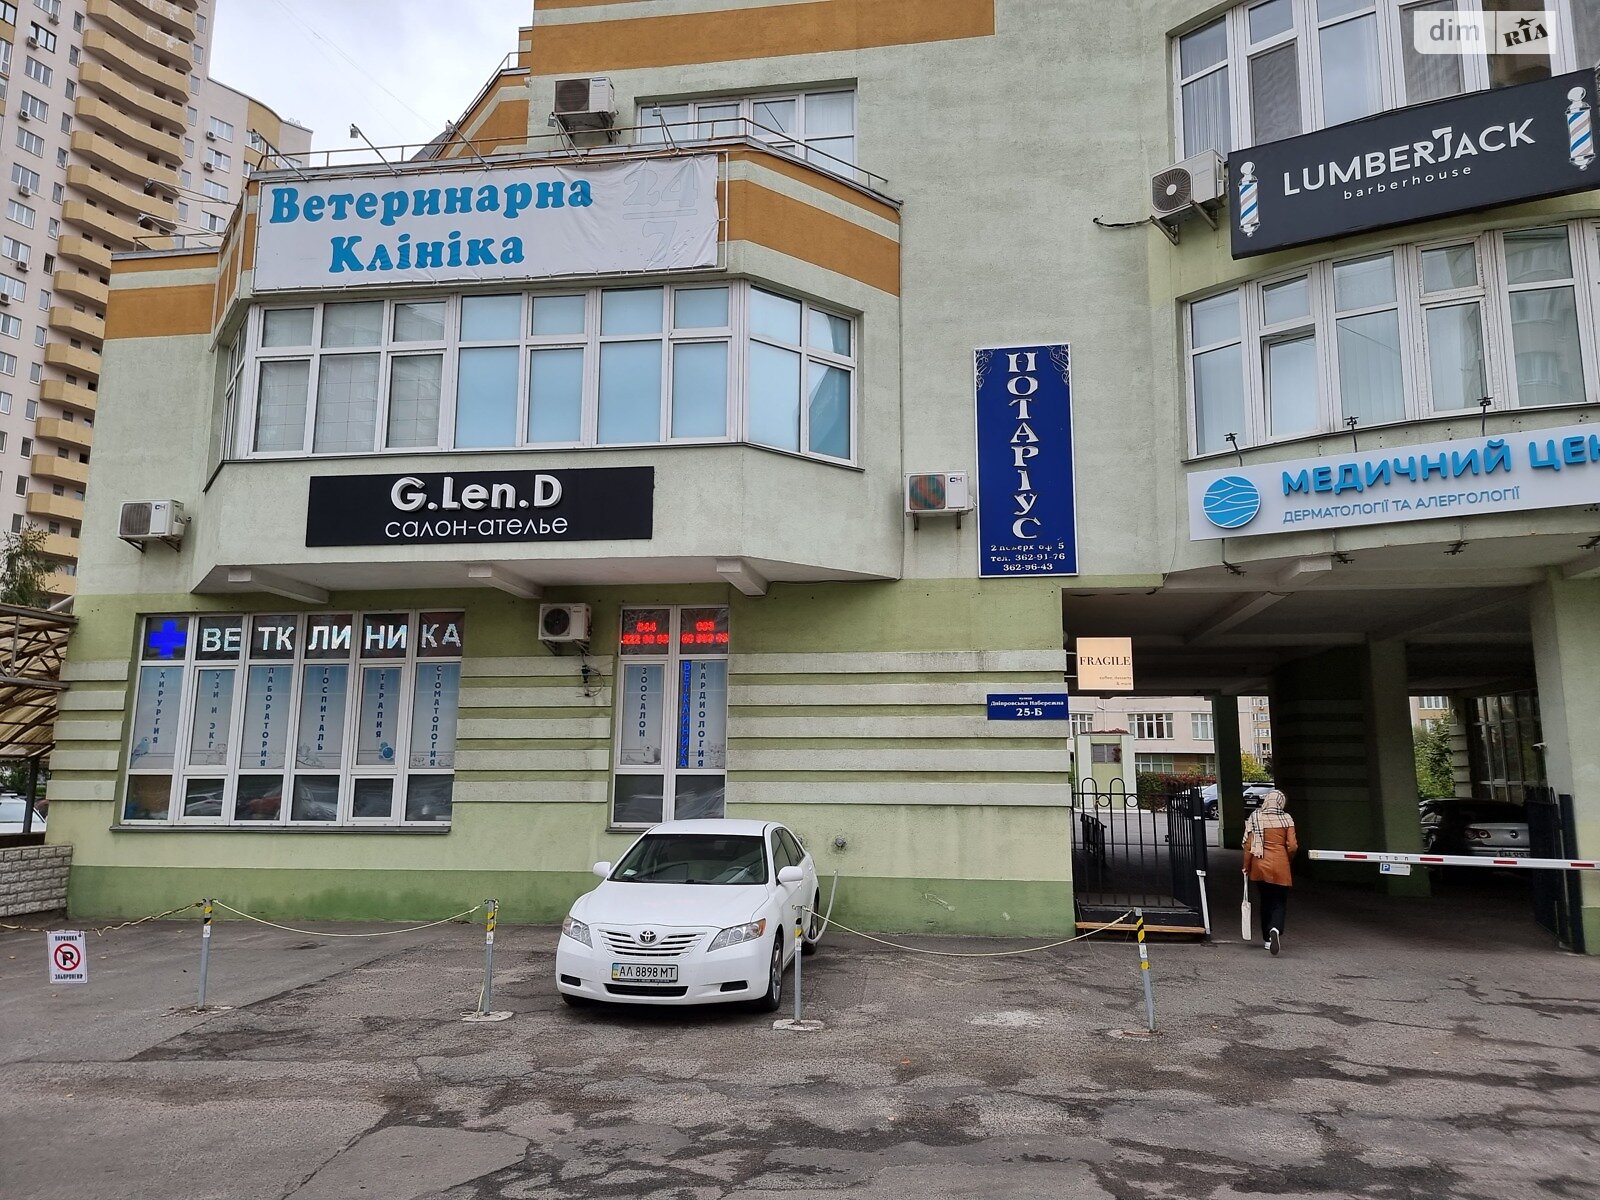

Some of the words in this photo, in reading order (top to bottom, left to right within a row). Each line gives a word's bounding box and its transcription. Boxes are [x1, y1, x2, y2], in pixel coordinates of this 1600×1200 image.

[1284, 118, 1536, 196] LUMBERJACK
[269, 179, 594, 226] Ветеринарна
[1344, 166, 1473, 200] barberhouse
[329, 231, 525, 273] Клініка
[1005, 352, 1041, 539] НОТАРІУС
[1282, 439, 1511, 496] МЕДИЧНИЙ
[391, 474, 563, 512] G.Len.D
[1283, 499, 1390, 524] ДЕРМАТОЛОГІЇ
[1392, 499, 1411, 511] ТА
[1415, 486, 1520, 509] АЛЕРГОЛОГІЇ
[385, 517, 568, 538] салон-ателье
[1015, 552, 1065, 561] 362-91-76
[1080, 656, 1131, 666] FRAGILE
[152, 671, 165, 744] ХИРУРГИЯ
[213, 672, 221, 698] УЗИ
[375, 673, 386, 738] ТЕРАПИЯ
[639, 667, 648, 737] ЗООСАЛОН
[260, 667, 274, 767] ЛАБОРАТОРИЯ
[317, 668, 329, 751] ГОСПИТАЛЬ
[429, 665, 442, 767] СТОМАТОЛОГИЯ
[698, 663, 706, 767] КАРДИОЛОГИЯ
[1016, 708, 1042, 716] 25-Б
[635, 966, 658, 977] 8898
[660, 967, 676, 978] MT
